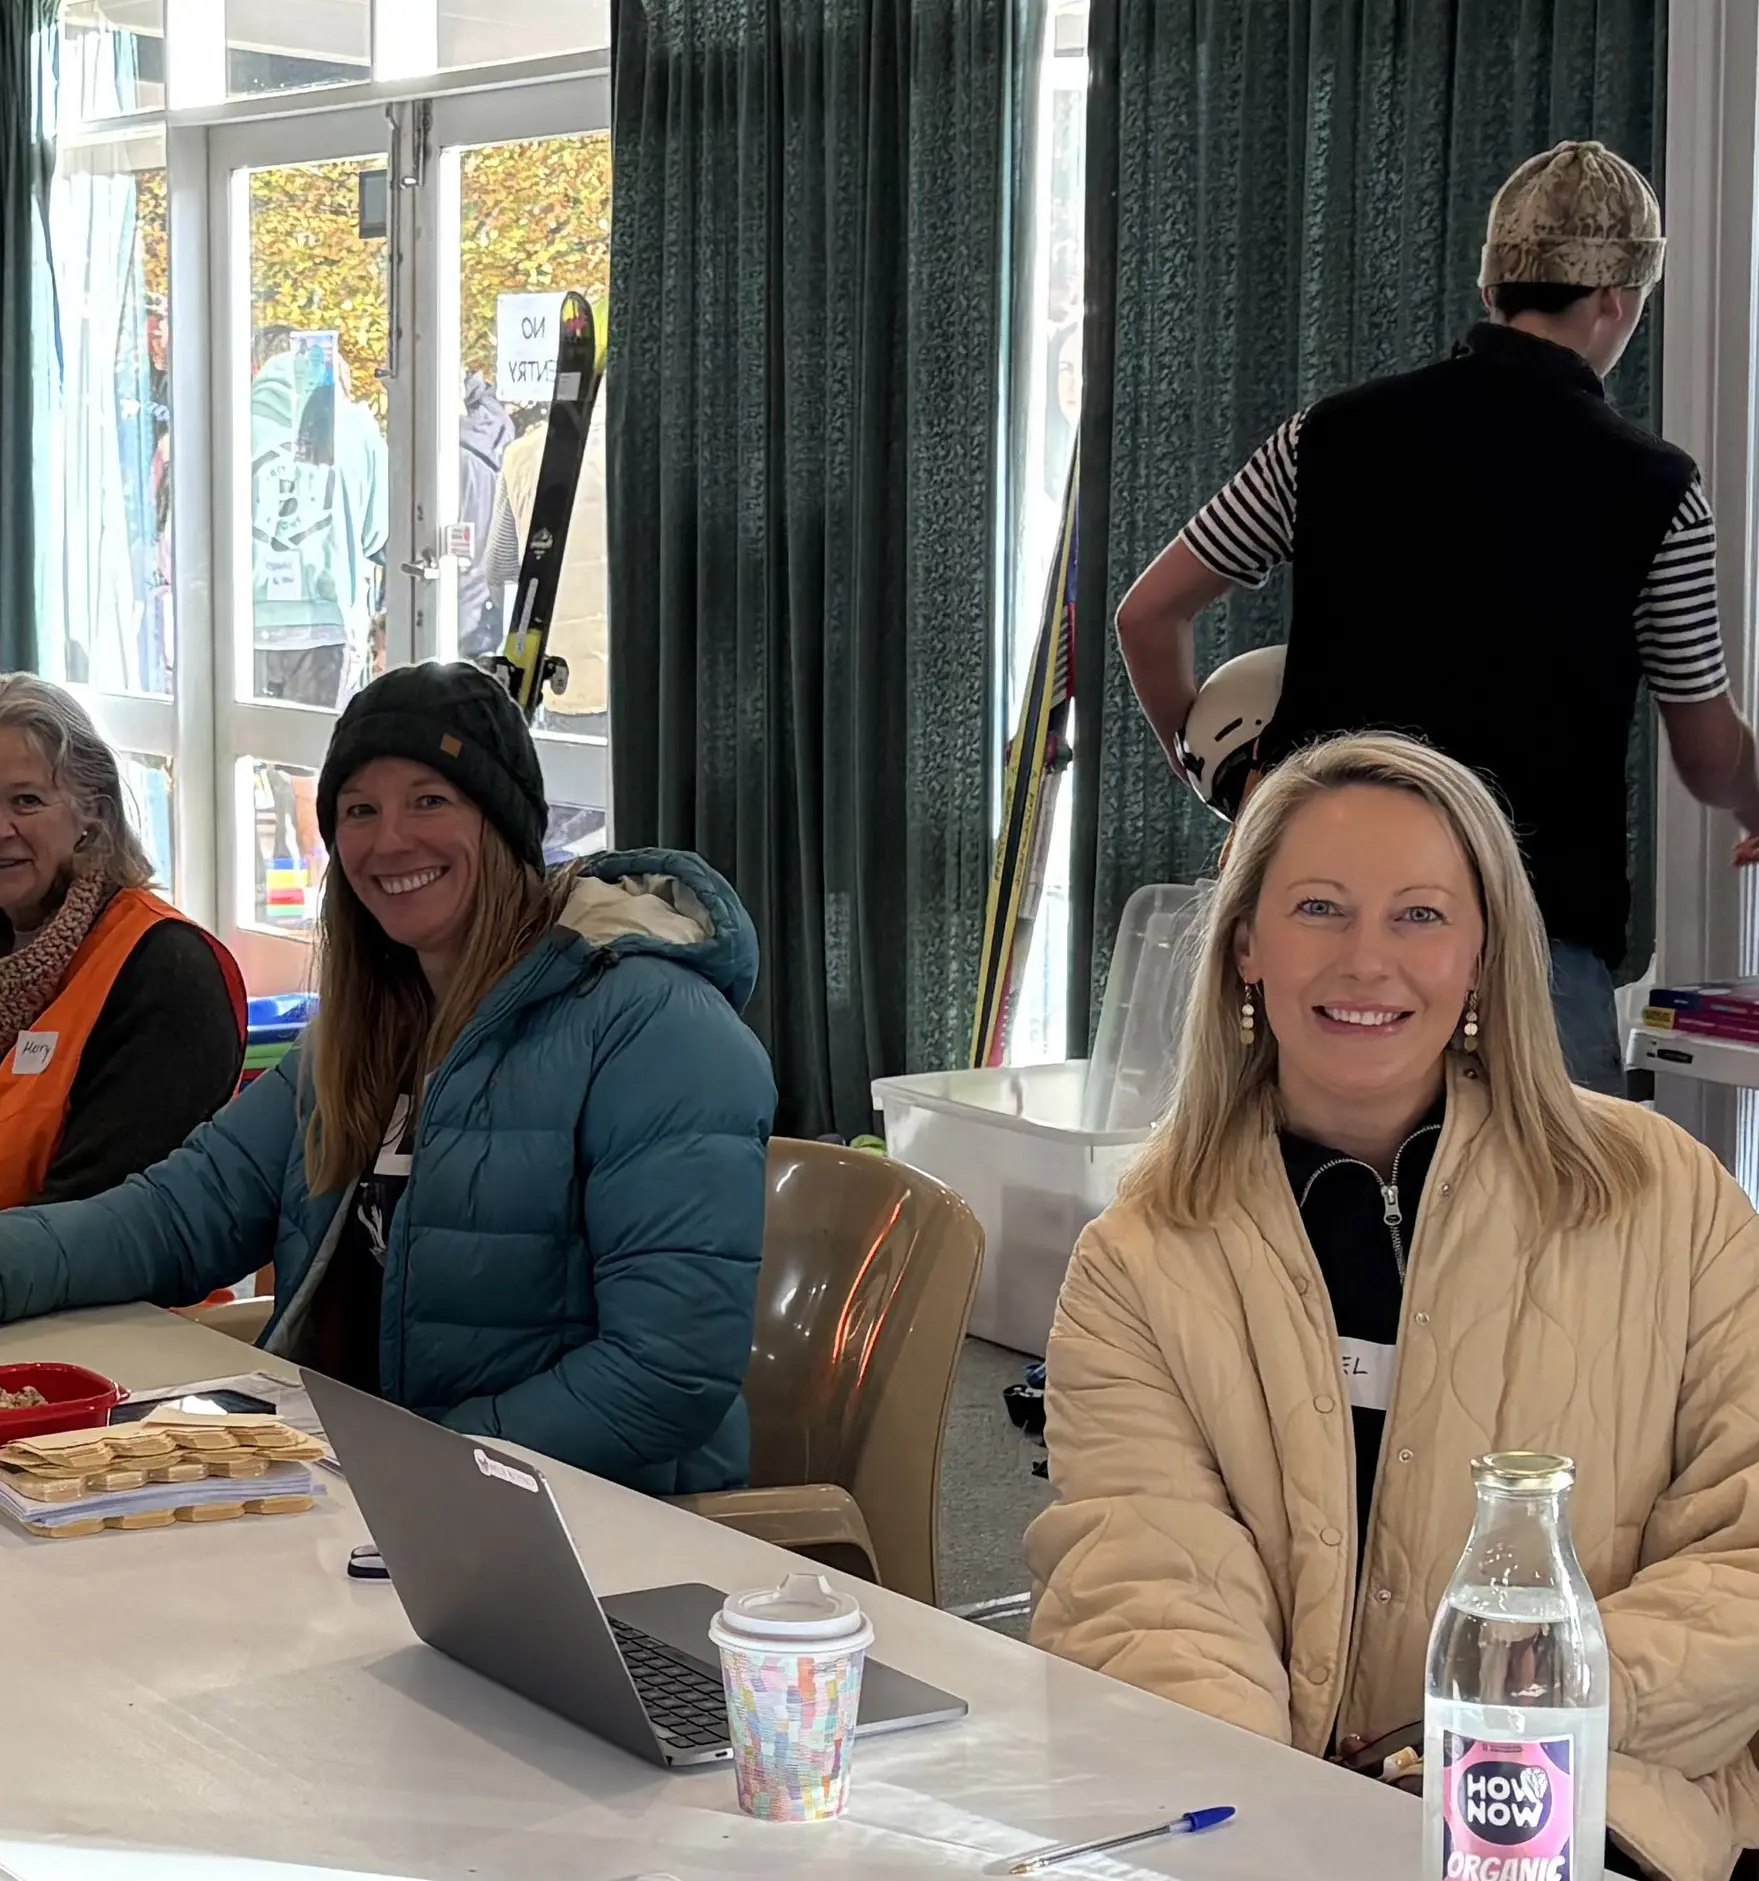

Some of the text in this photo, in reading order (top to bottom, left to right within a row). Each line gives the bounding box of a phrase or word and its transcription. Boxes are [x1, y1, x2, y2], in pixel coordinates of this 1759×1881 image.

[1466, 1771, 1548, 1803] HOW
[1466, 1799, 1544, 1828] NOW
[1447, 1851, 1566, 1881] ORGANIC
